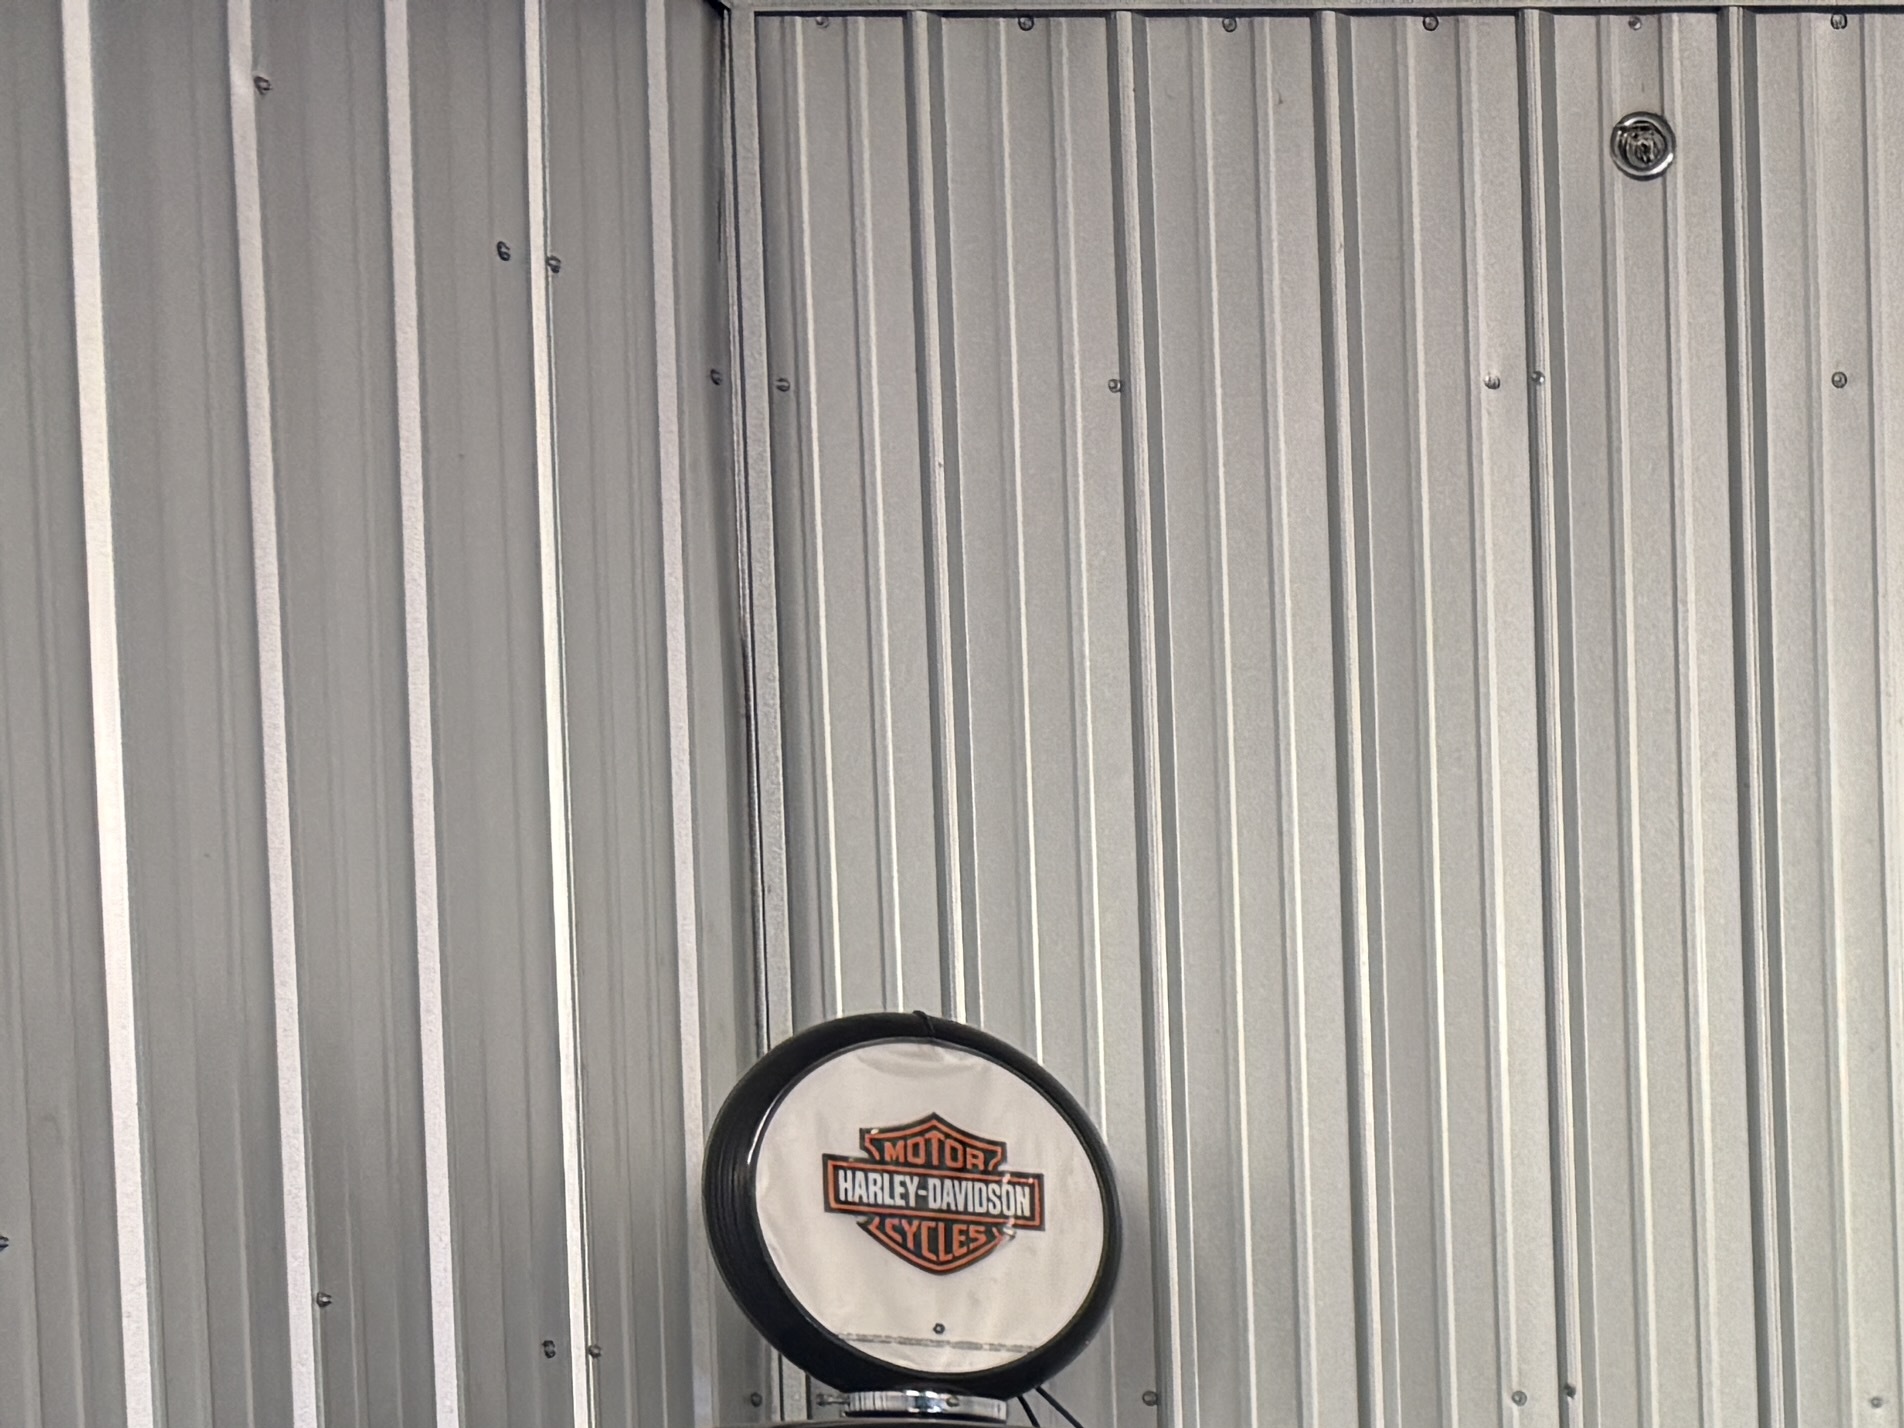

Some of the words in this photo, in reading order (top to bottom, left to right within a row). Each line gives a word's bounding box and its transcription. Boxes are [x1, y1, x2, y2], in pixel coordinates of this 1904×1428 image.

[884, 1132, 986, 1170] MOTOR
[838, 1169, 1032, 1217] HARLEY-DAVIDSON
[885, 1219, 988, 1262] CYCLES
